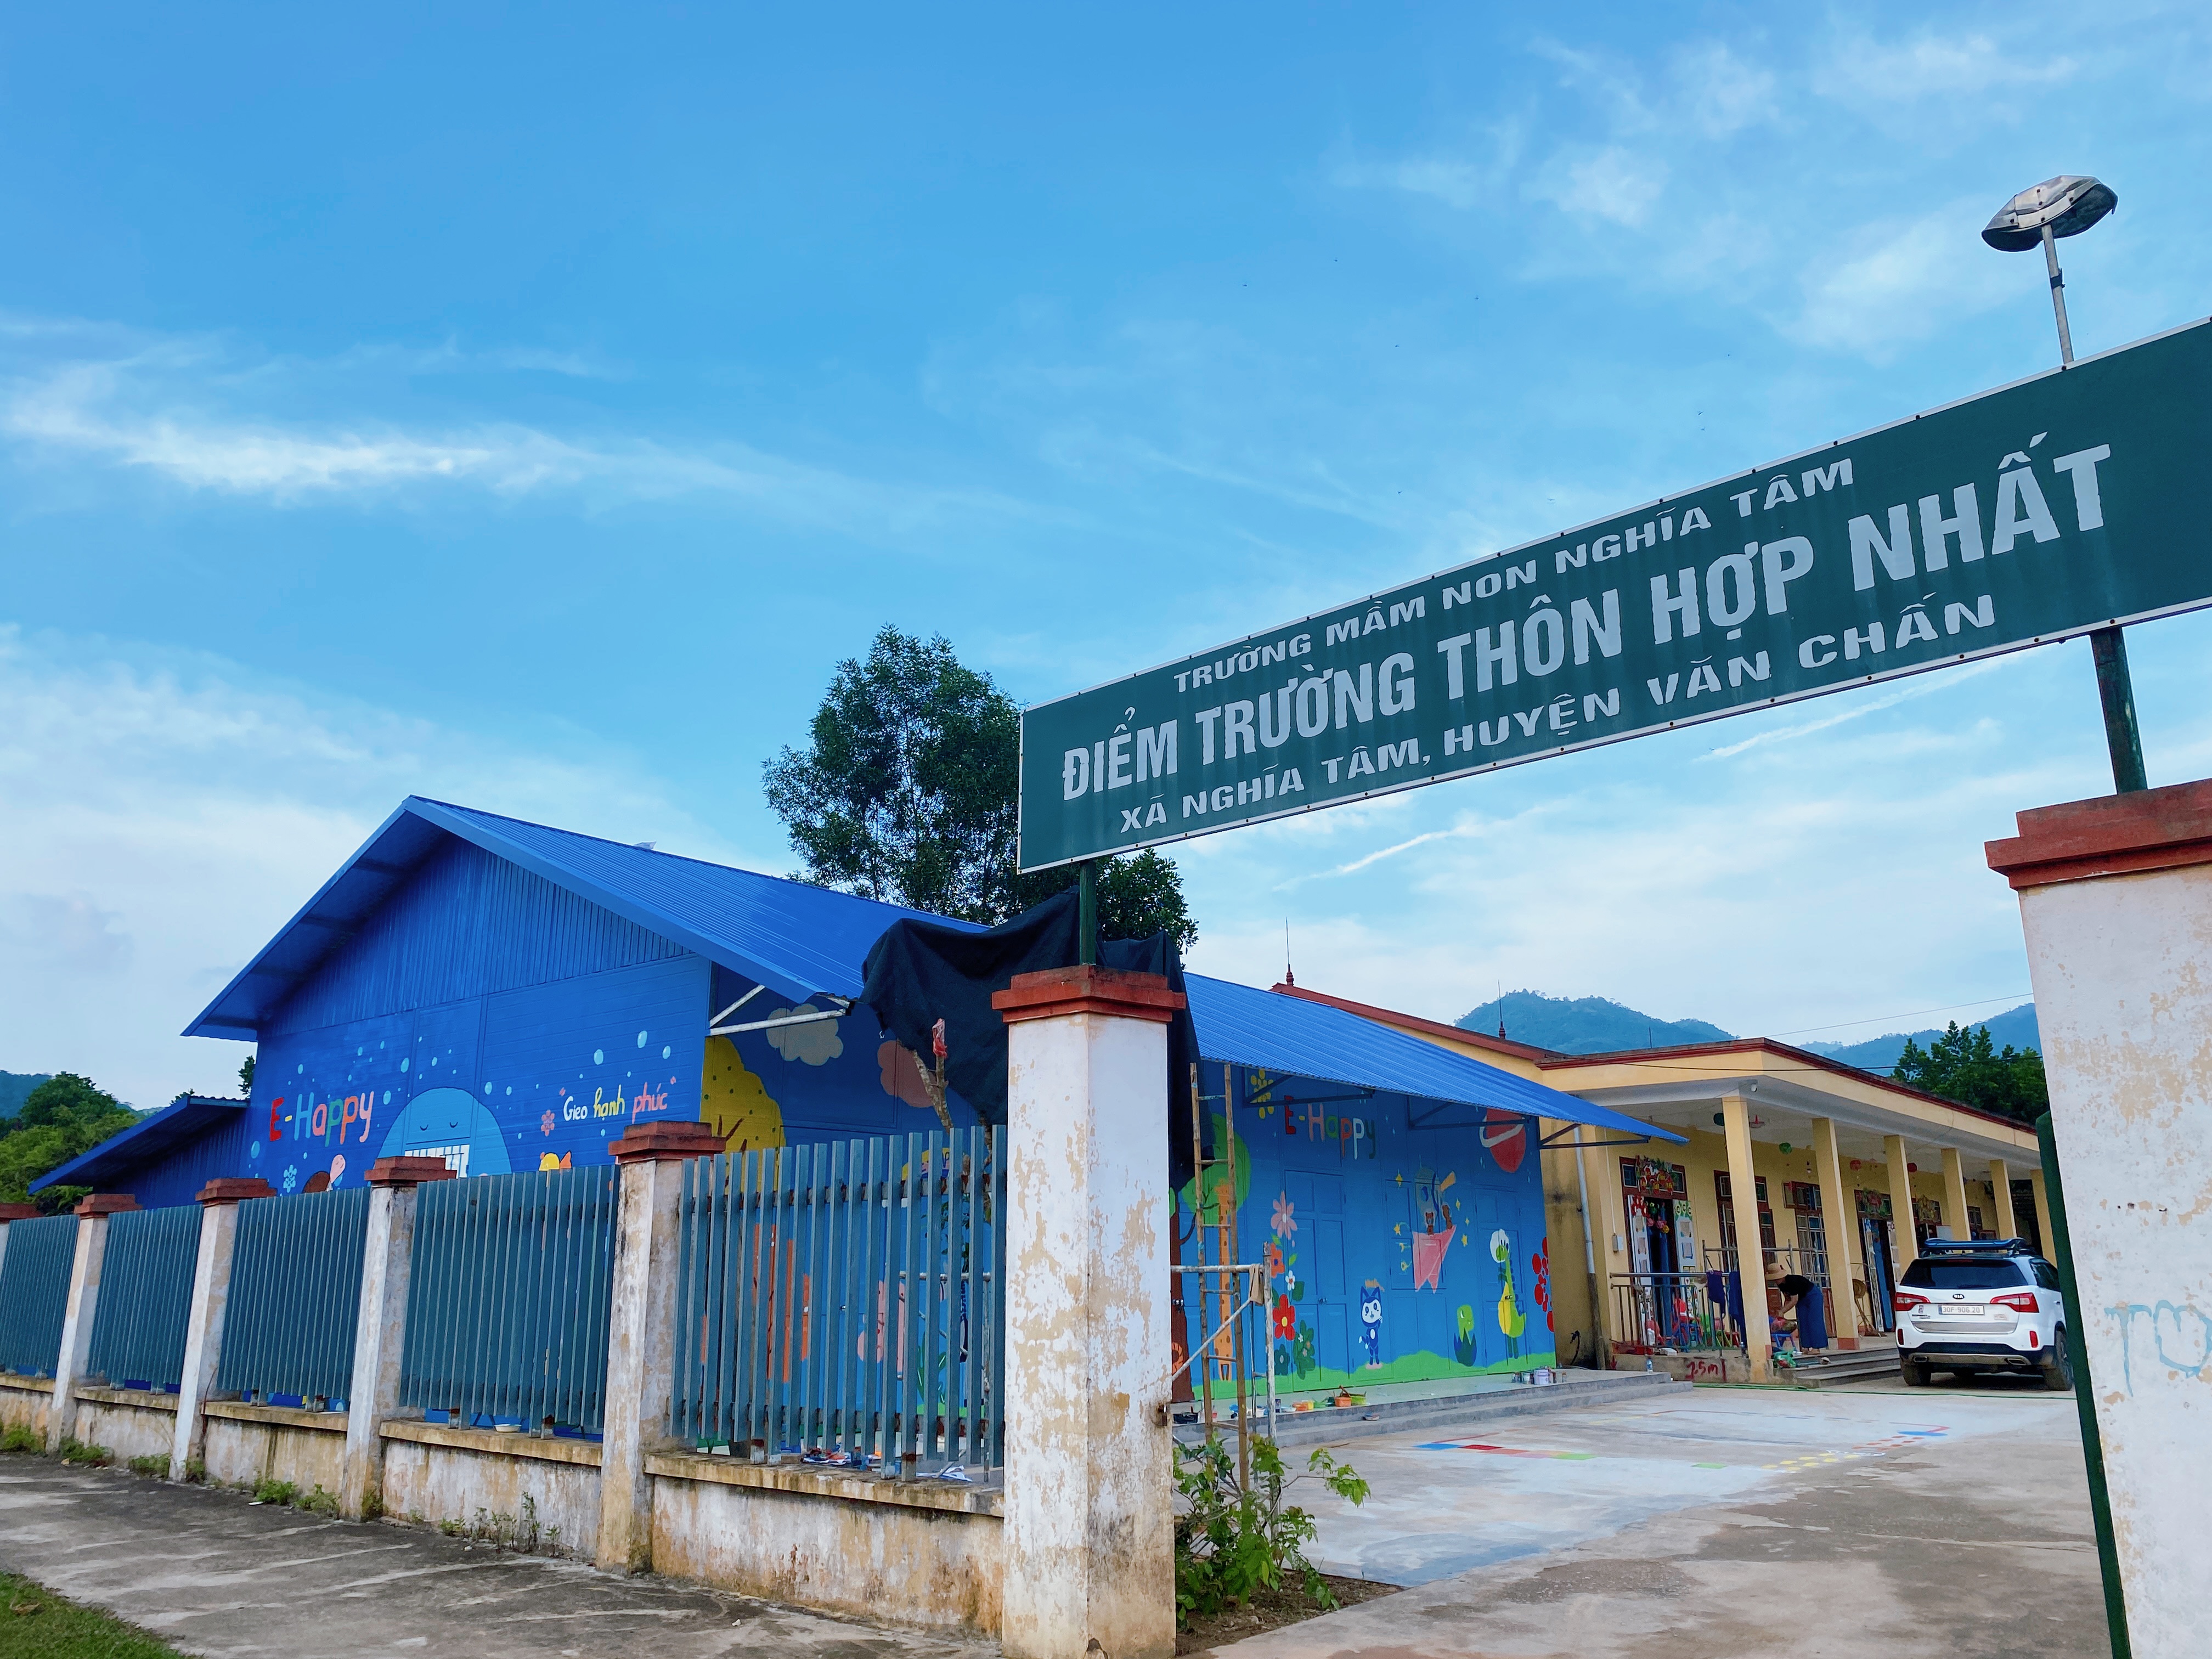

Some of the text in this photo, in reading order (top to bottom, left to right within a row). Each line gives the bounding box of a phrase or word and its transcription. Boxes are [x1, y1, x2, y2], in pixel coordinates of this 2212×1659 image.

[1062, 431, 2111, 800] ĐIỂM TRƯỜNG THÔN HỢP NHẤT
[1173, 633, 1312, 693] TRƯỜNG
[1442, 560, 1537, 610] NON
[1555, 508, 1713, 574] NGHĨA
[1729, 458, 1854, 517] TÂM
[1120, 592, 1995, 833] XÃ NGHĨA TÂM, HUYỆN VĂN CHẤN
[594, 1084, 625, 1121] hạnh
